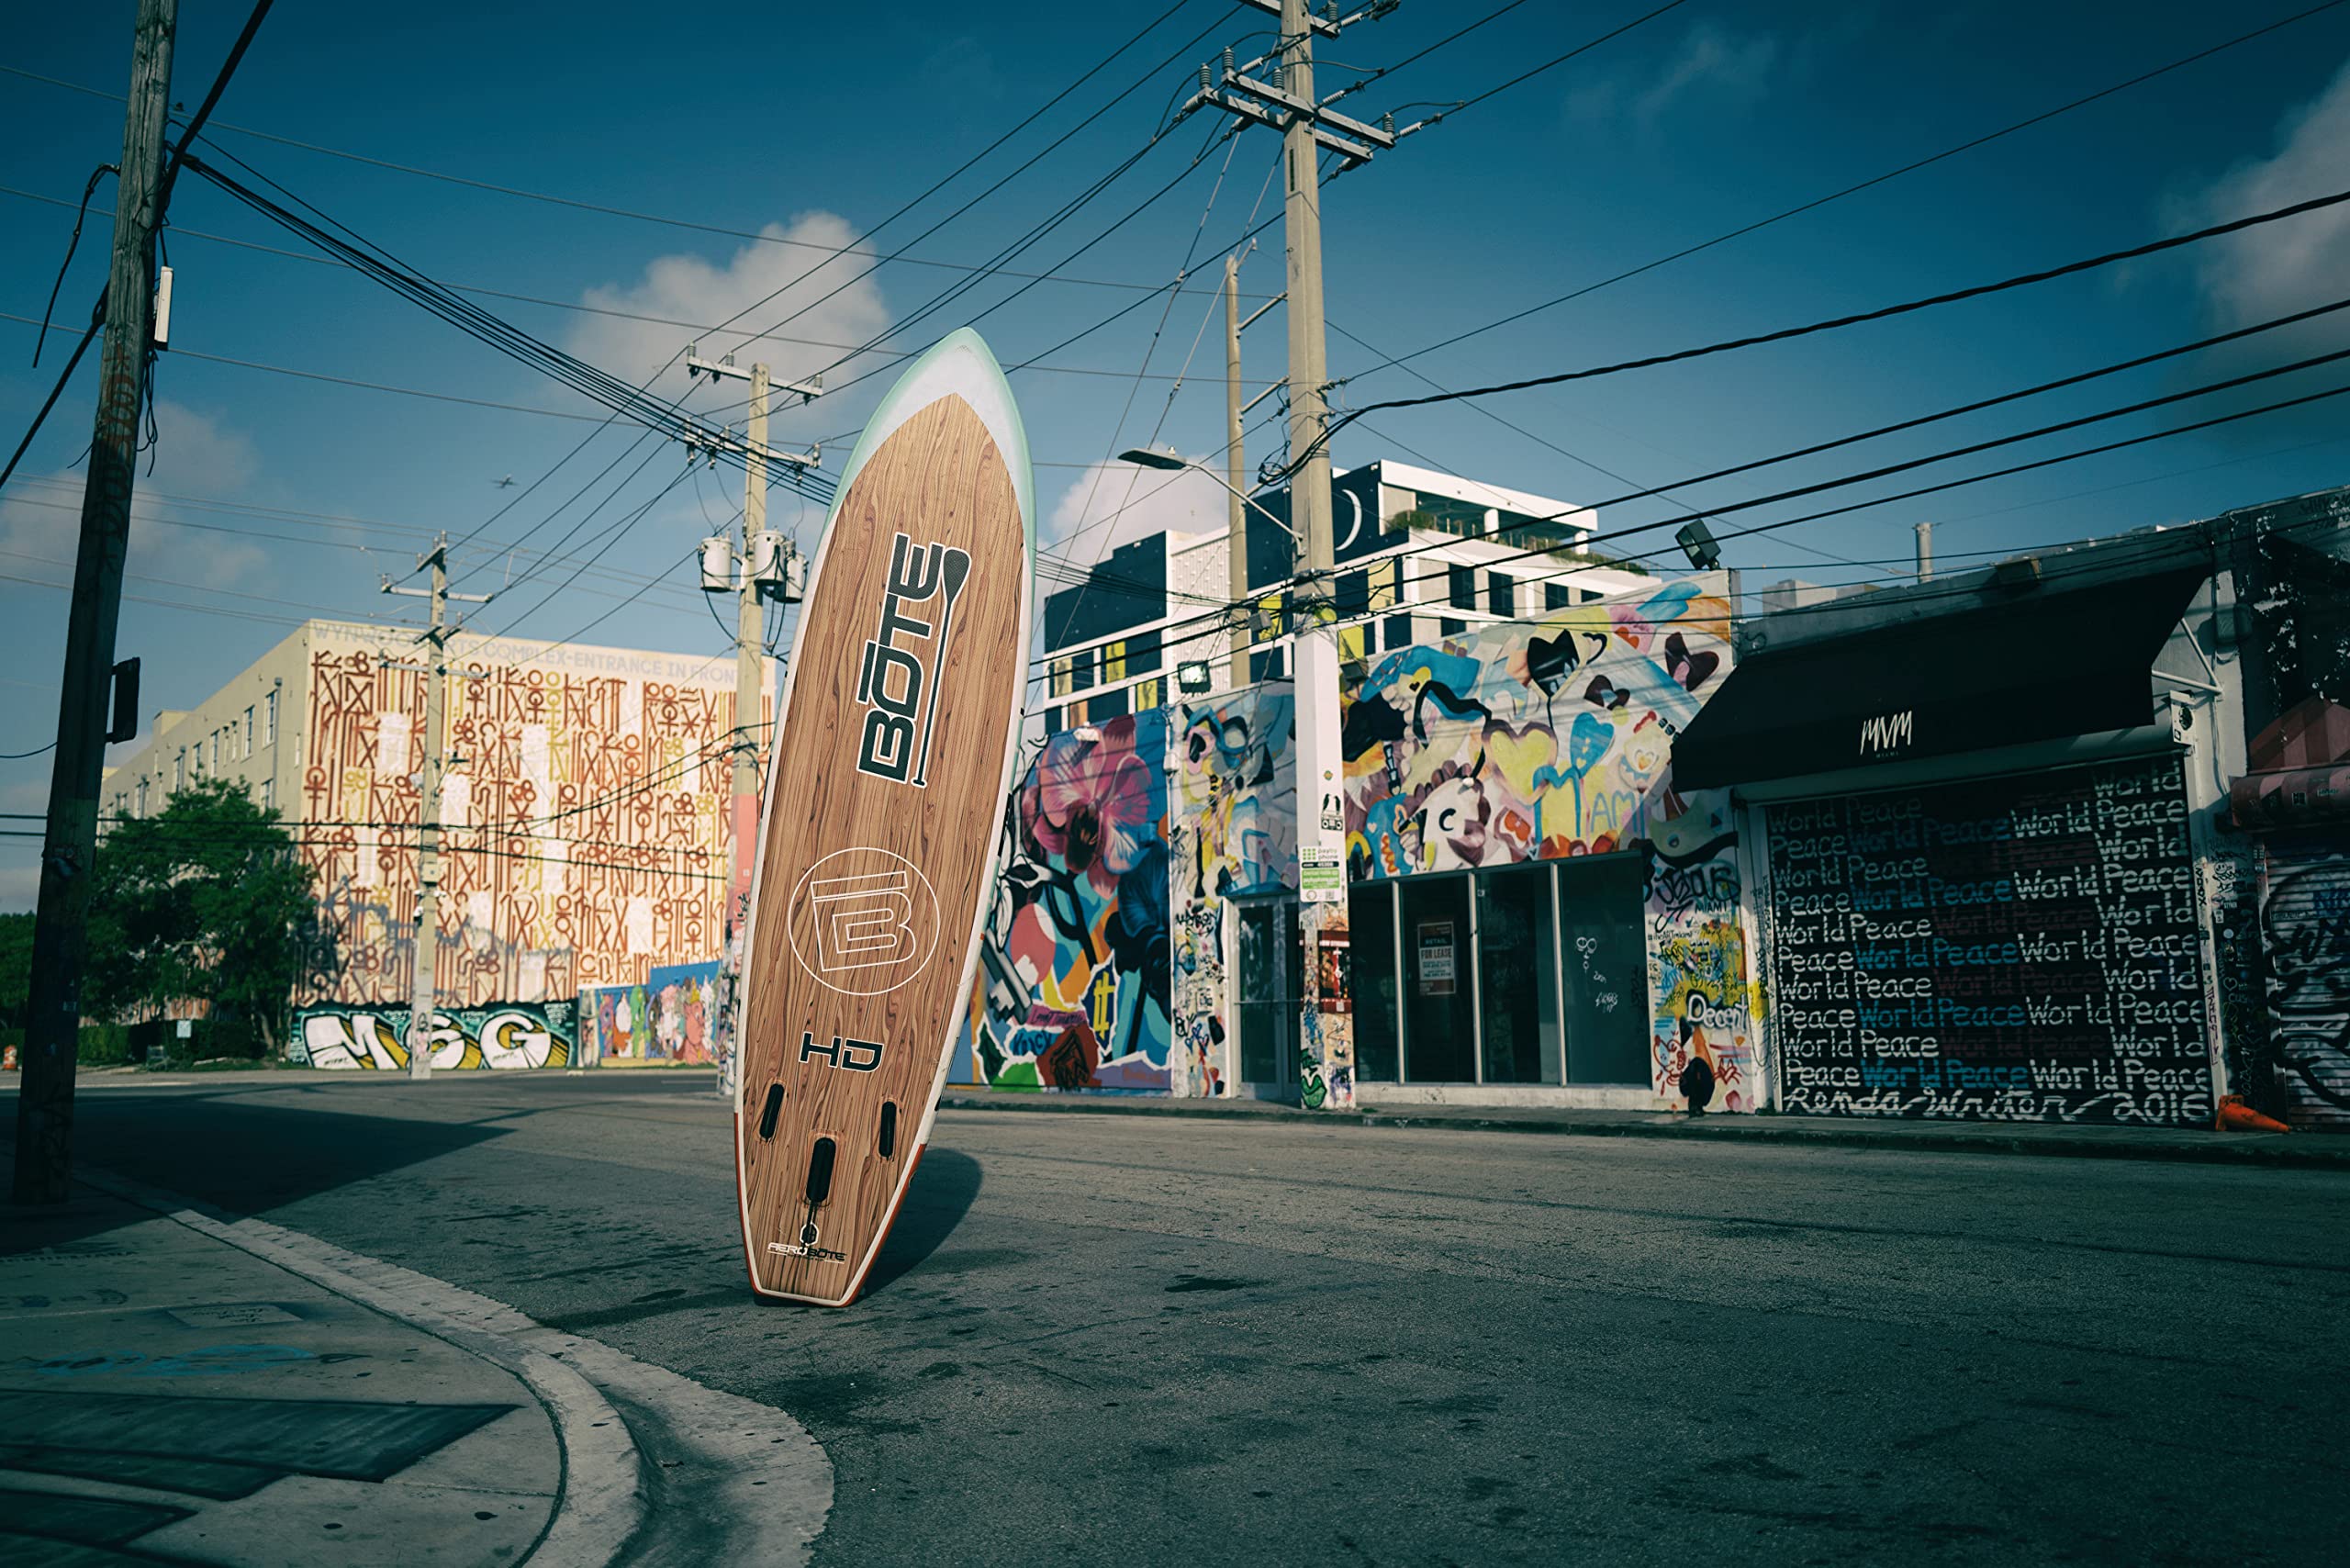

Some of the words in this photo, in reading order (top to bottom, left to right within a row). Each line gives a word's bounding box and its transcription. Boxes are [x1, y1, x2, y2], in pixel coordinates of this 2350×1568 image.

[666, 662, 687, 678] IN
[689, 666, 740, 685] FRON
[1767, 800, 1837, 833] World
[1845, 796, 1923, 825] Peace
[1770, 834, 1848, 860] Peace
[2010, 801, 2093, 839] World
[2096, 799, 2188, 830] Peace
[1772, 856, 1841, 889] World
[1847, 854, 1930, 882] Peace
[2094, 825, 2189, 862] World
[1774, 890, 1851, 917] Peace
[1851, 879, 1925, 912] World
[1929, 878, 2012, 907] Peace
[2013, 865, 2099, 901] World
[2103, 863, 2192, 894] Peace
[1774, 913, 1846, 945] World
[1849, 913, 1932, 941] Peace
[2095, 890, 2195, 927] World
[1421, 949, 1432, 959] FOR
[1433, 947, 1452, 958] LEASE
[1777, 946, 1854, 973] Peace
[1854, 939, 1929, 969] World
[1932, 937, 2020, 967] Peace
[2018, 928, 2108, 962] World
[2113, 927, 2199, 959] Peace
[1778, 970, 1849, 1001] World
[1854, 969, 1932, 999] Peace
[2101, 958, 2199, 991] World
[1687, 992, 1749, 1034] Decent
[1780, 1002, 1856, 1029] Peace
[1856, 997, 1933, 1029] World
[1937, 997, 2027, 1028] Peace
[2025, 992, 2112, 1026] World
[2118, 992, 2205, 1025] Peace
[799, 1031, 885, 1072] HD
[1782, 1029, 1852, 1058] World
[1859, 1028, 1940, 1058] Peace
[2109, 1025, 2207, 1057] World
[1785, 1058, 1862, 1087] Peace
[1860, 1057, 1942, 1088] World
[1945, 1058, 2030, 1089] Peace
[2030, 1058, 2119, 1091] World
[2123, 1058, 2210, 1092] Peace
[1783, 1086, 1914, 1117] Renda
[1914, 1083, 2111, 1122] Writer
[2112, 1092, 2210, 1124] 2016
